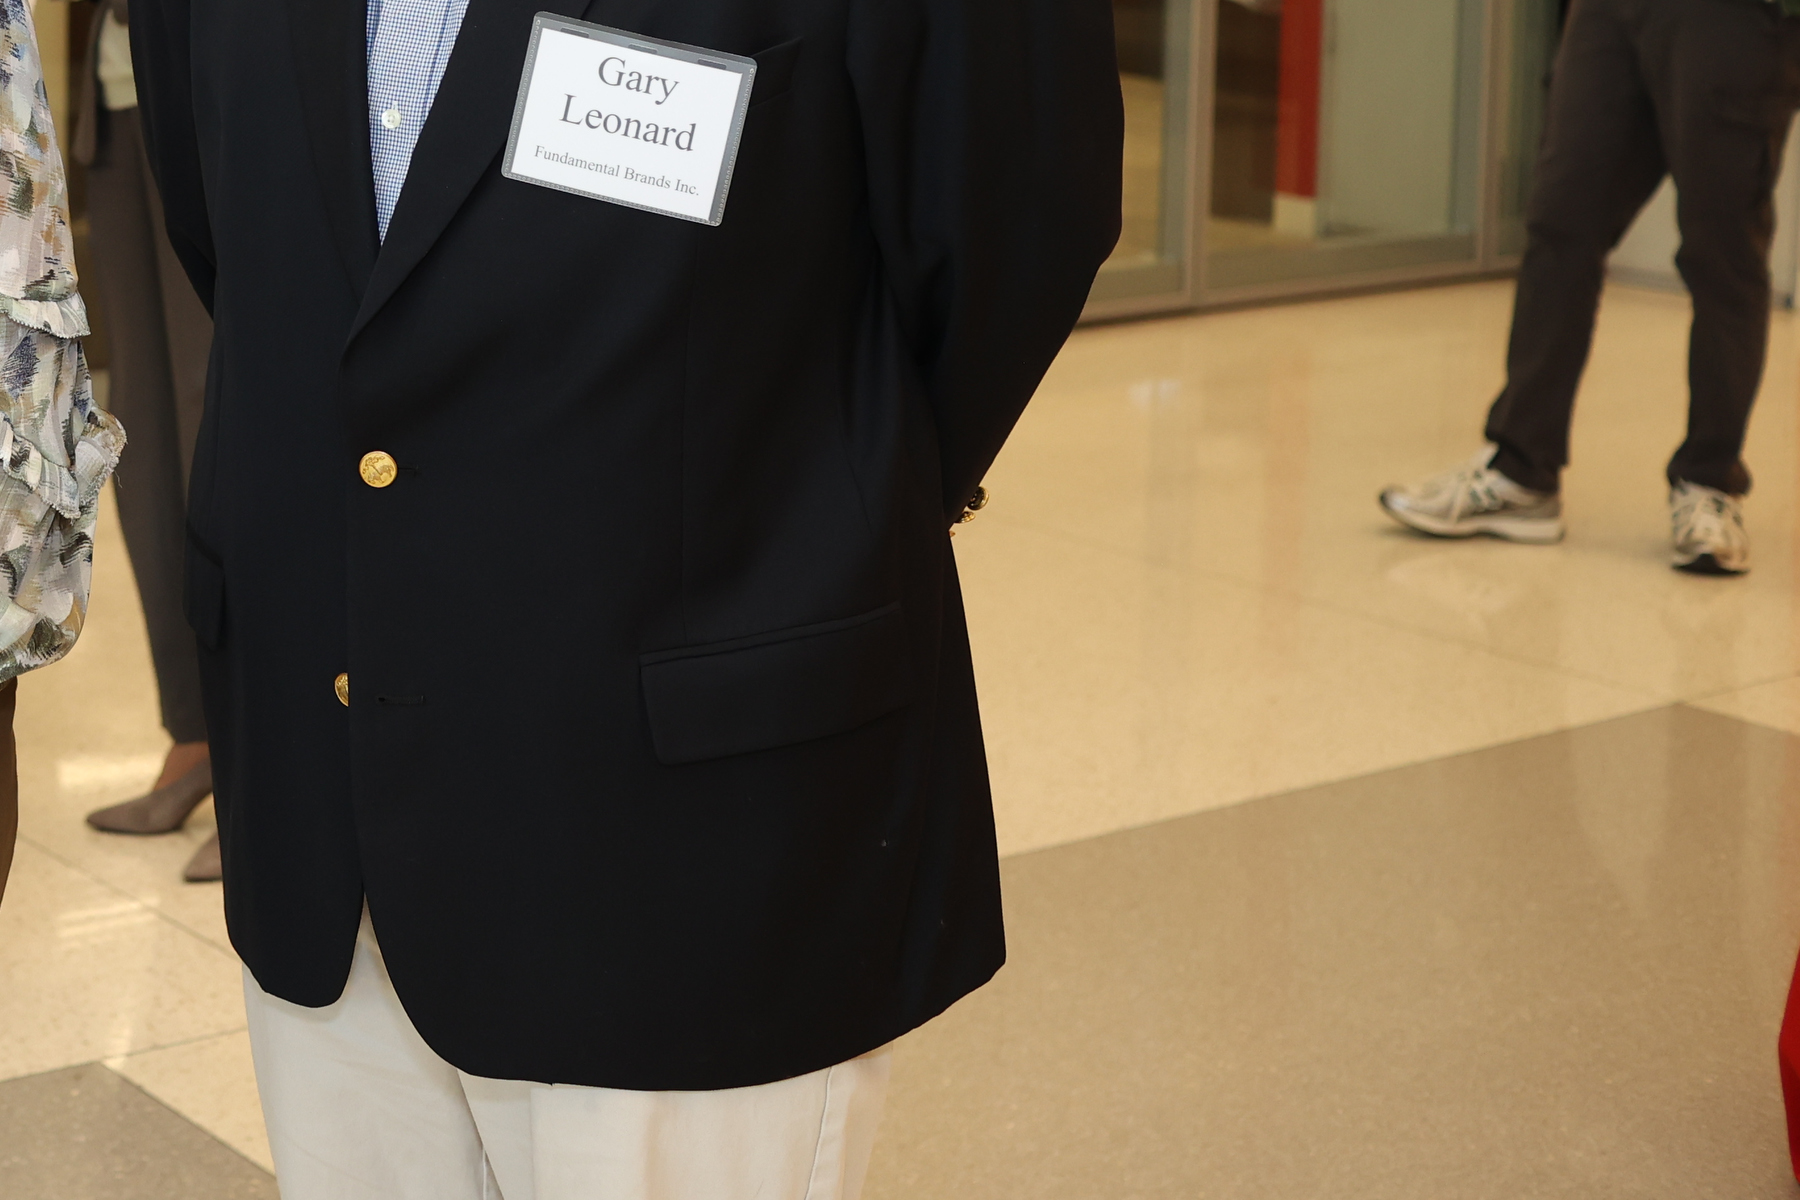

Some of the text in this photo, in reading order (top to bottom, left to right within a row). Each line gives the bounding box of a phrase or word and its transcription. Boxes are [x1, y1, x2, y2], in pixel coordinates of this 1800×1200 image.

[598, 57, 680, 105] Gary
[559, 93, 697, 152] Leonard
[534, 145, 700, 196] Fundamental Brands Inc.
